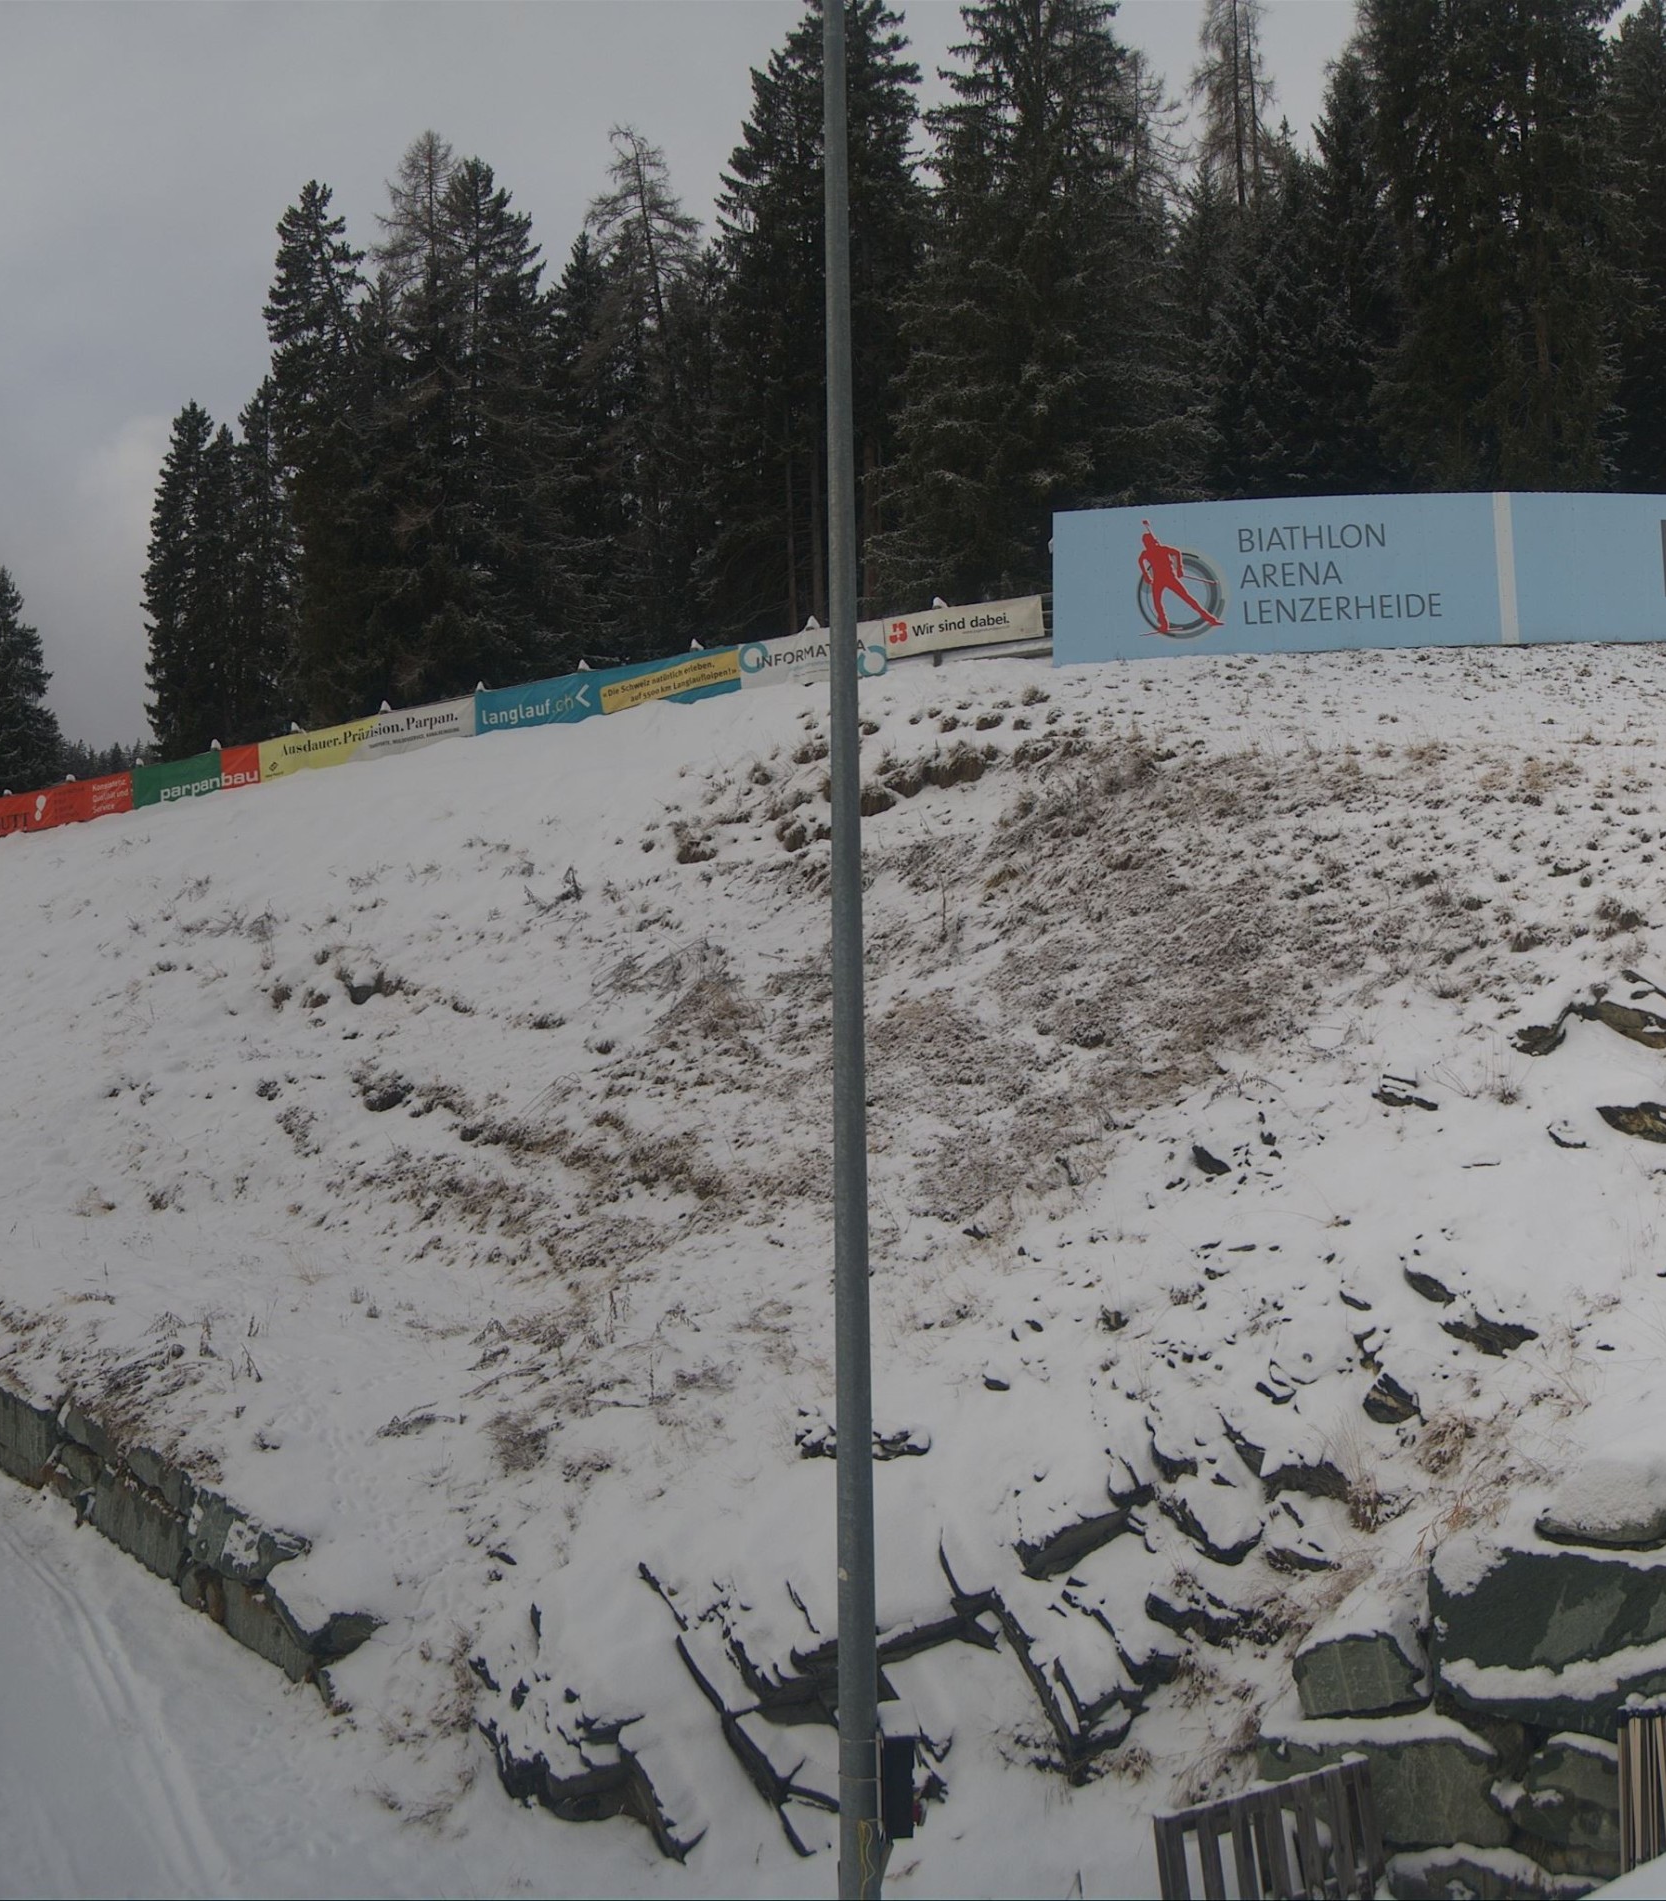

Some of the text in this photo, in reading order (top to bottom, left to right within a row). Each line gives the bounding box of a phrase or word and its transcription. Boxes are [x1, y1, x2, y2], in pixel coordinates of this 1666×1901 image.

[1237, 523, 1386, 553] BIATHLON
[1240, 560, 1343, 589] ARENA
[1243, 592, 1443, 625] LENZERHEIDE
[911, 612, 1010, 637] Wir sind dabei.
[756, 639, 867, 669] INFORMAA
[621, 680, 650, 696] Schweiz
[652, 670, 683, 685] natürlich
[684, 661, 715, 675] erleben,
[630, 693, 642, 703] auf
[643, 688, 660, 699] 5500
[661, 683, 672, 693] km
[481, 694, 575, 725] langlauf.ch
[160, 770, 259, 802] parpanbau
[92, 802, 115, 814] Service
